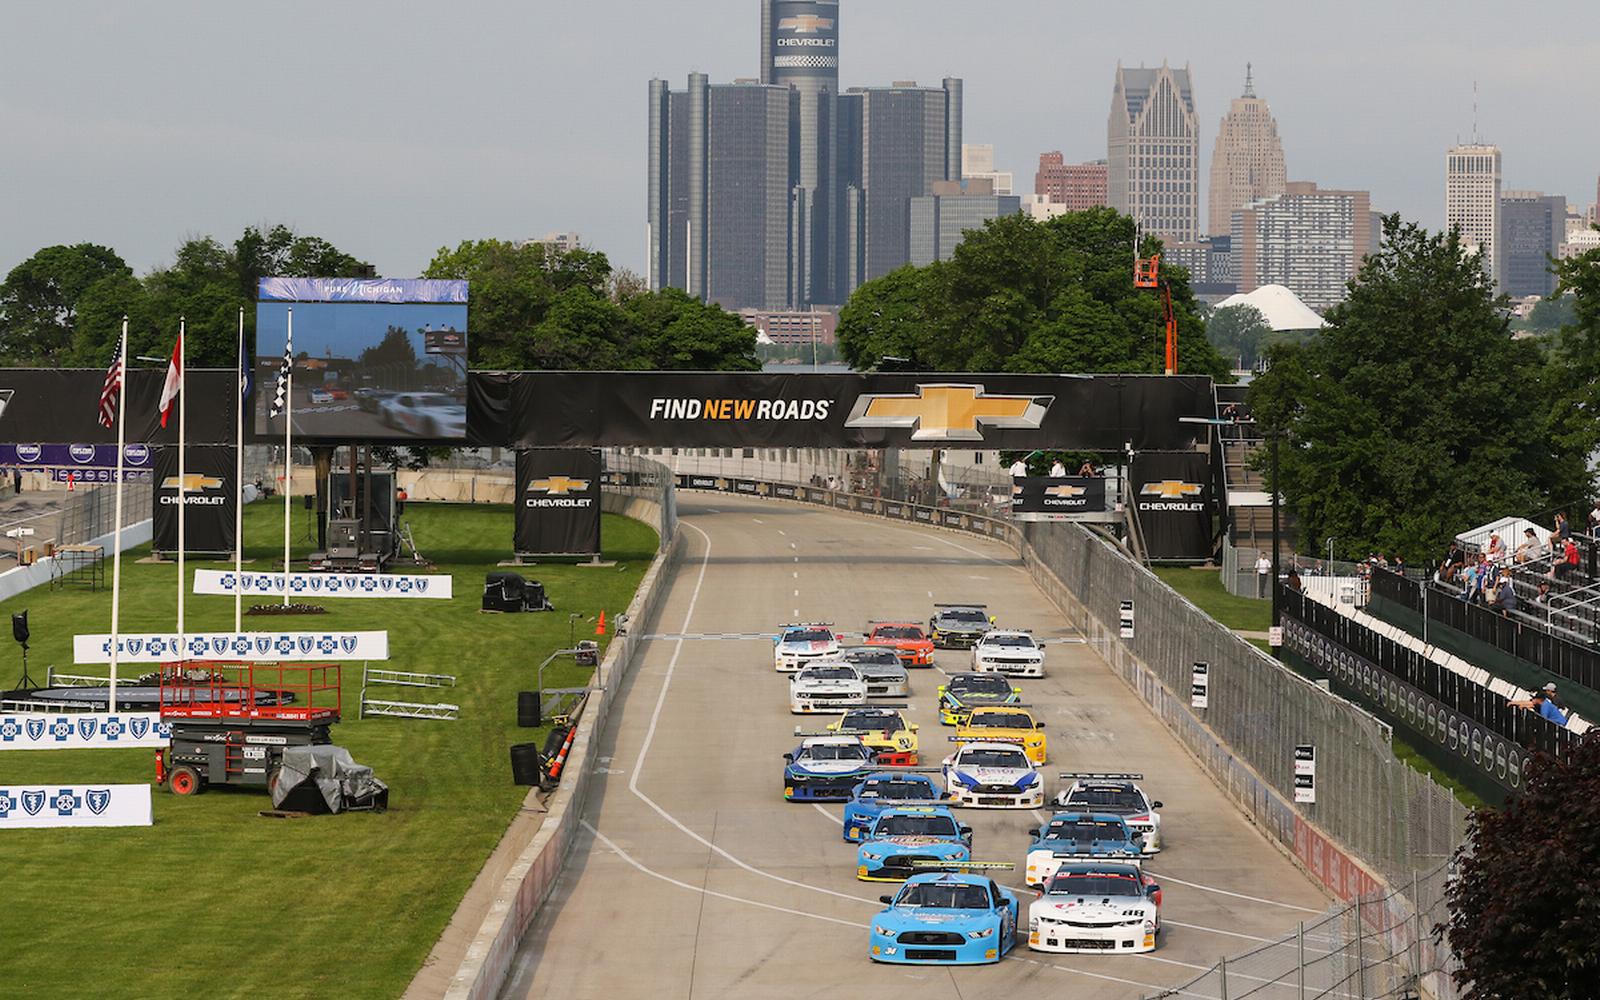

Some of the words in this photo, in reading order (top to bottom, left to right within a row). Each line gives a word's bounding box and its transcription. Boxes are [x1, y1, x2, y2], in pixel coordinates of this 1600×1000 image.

[777, 38, 835, 47] CHEVROLET
[340, 279, 403, 298] MICHIGAN
[649, 399, 702, 420] FIND
[703, 399, 755, 420] NEW
[756, 400, 829, 420] ROADS
[526, 498, 592, 508] CHEVROLET
[1139, 502, 1204, 512] CHEVROLET
